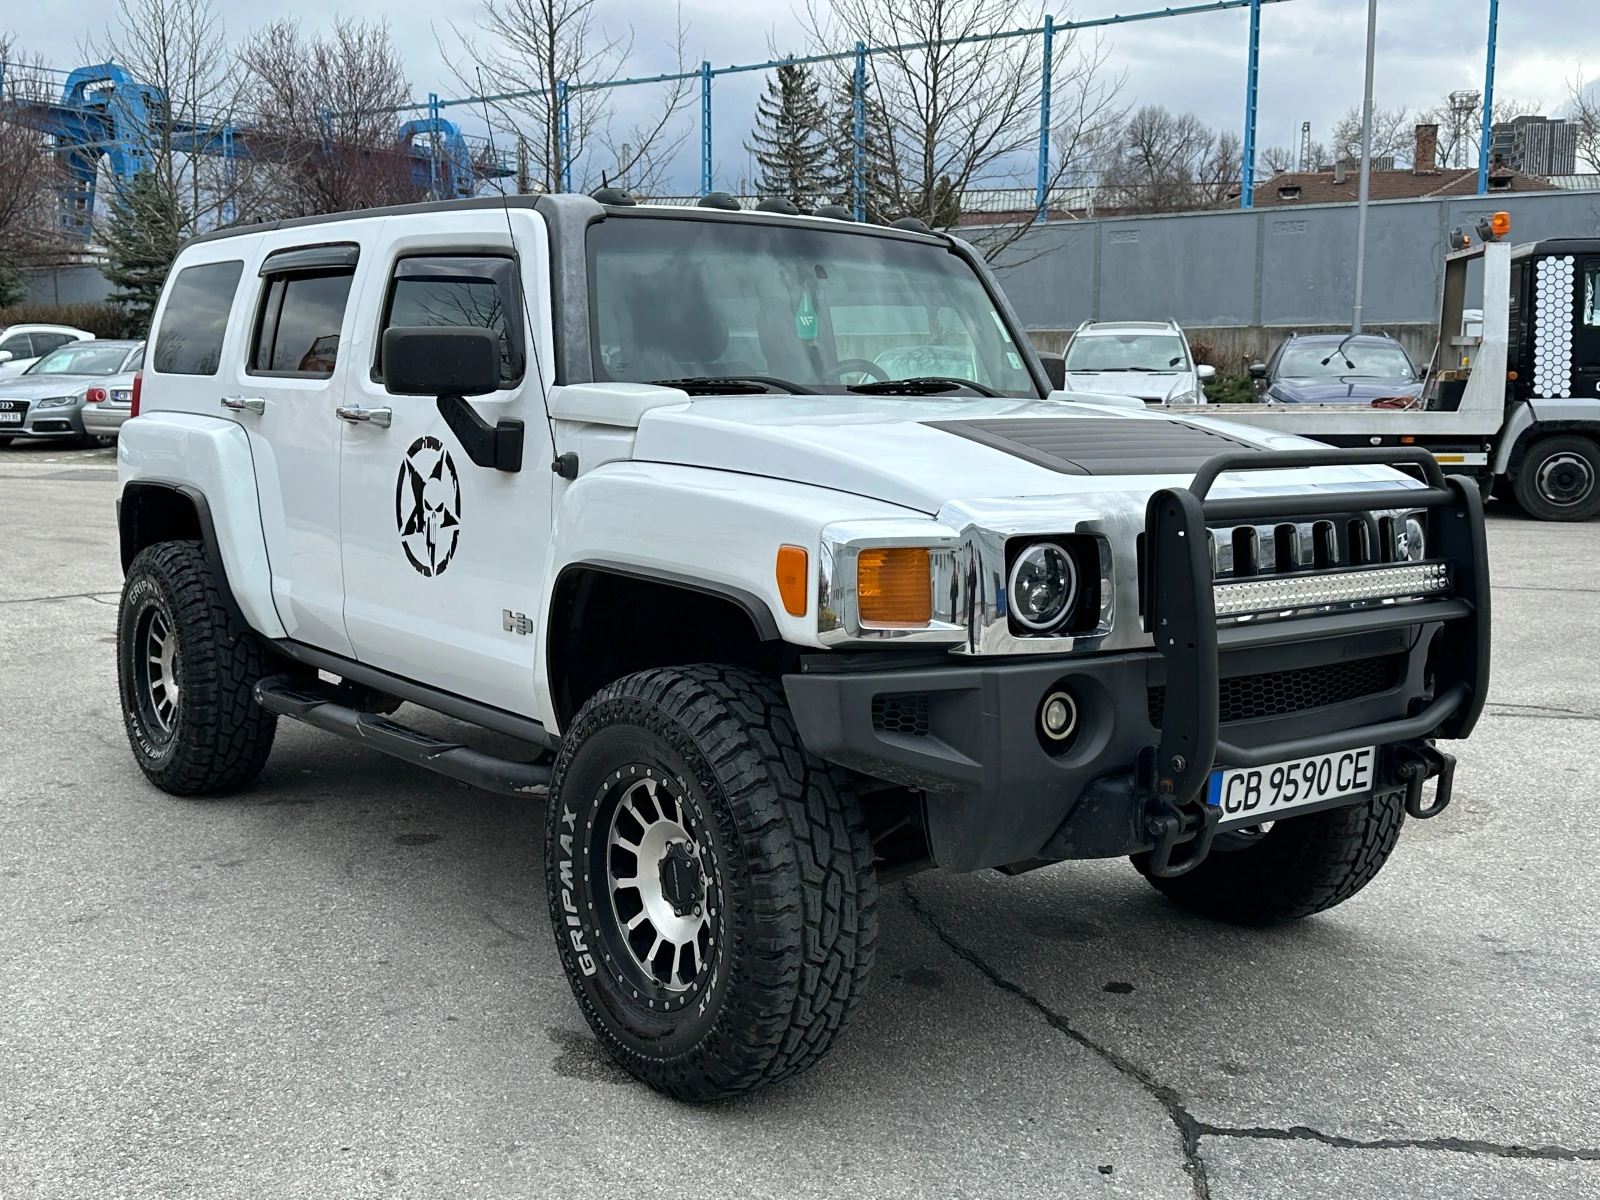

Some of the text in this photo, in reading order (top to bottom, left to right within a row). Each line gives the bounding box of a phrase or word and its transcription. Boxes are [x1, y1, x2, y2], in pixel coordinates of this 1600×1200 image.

[1225, 750, 1370, 814] CB 9590 CE
[560, 802, 597, 977] GRIPMAX
